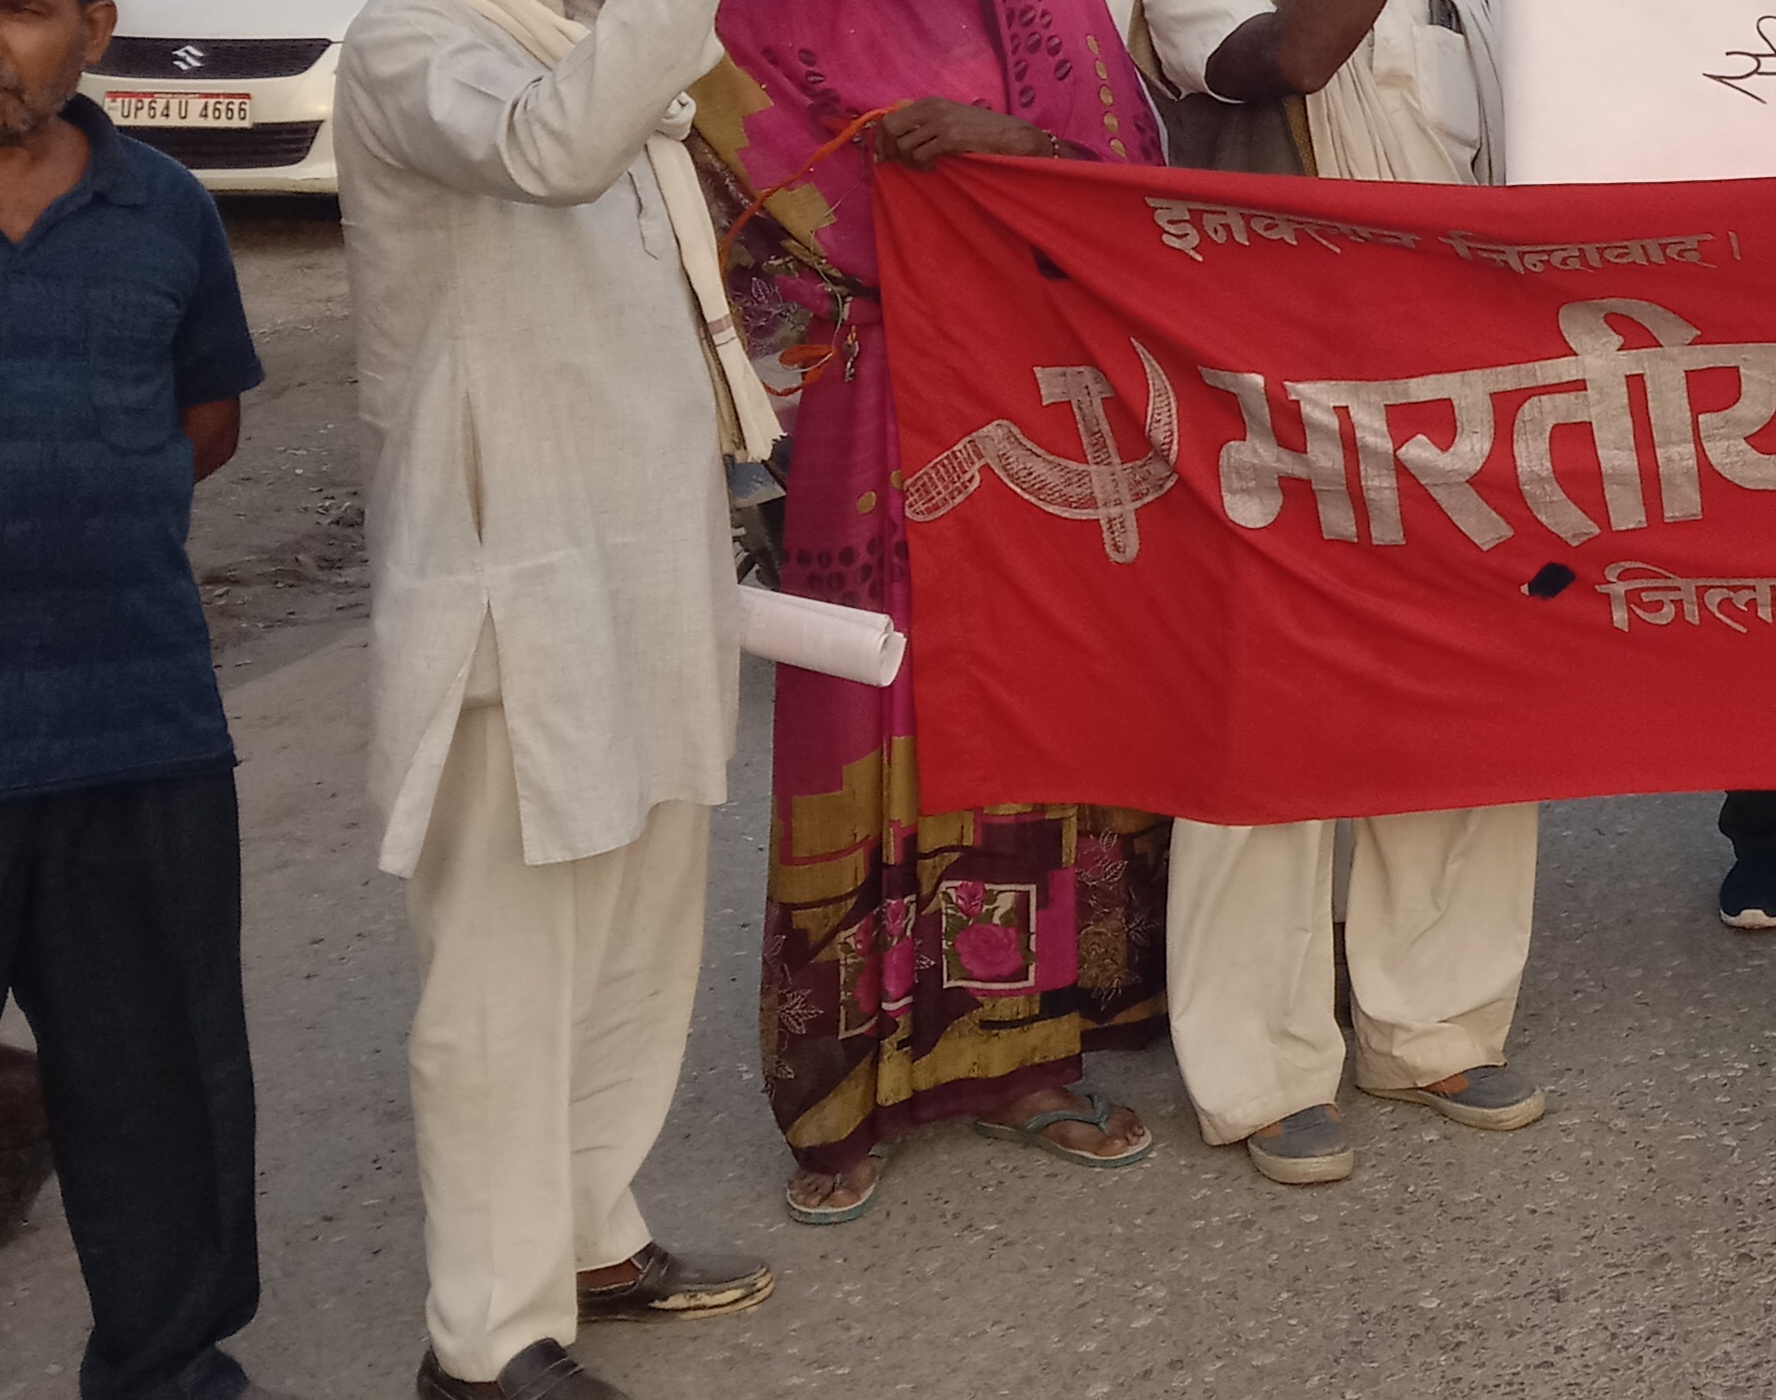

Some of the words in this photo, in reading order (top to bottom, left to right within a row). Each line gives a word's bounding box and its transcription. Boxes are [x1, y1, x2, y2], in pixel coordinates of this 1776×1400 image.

[121, 99, 170, 120] UP64
[178, 99, 189, 120] U
[199, 100, 248, 121] 4666
